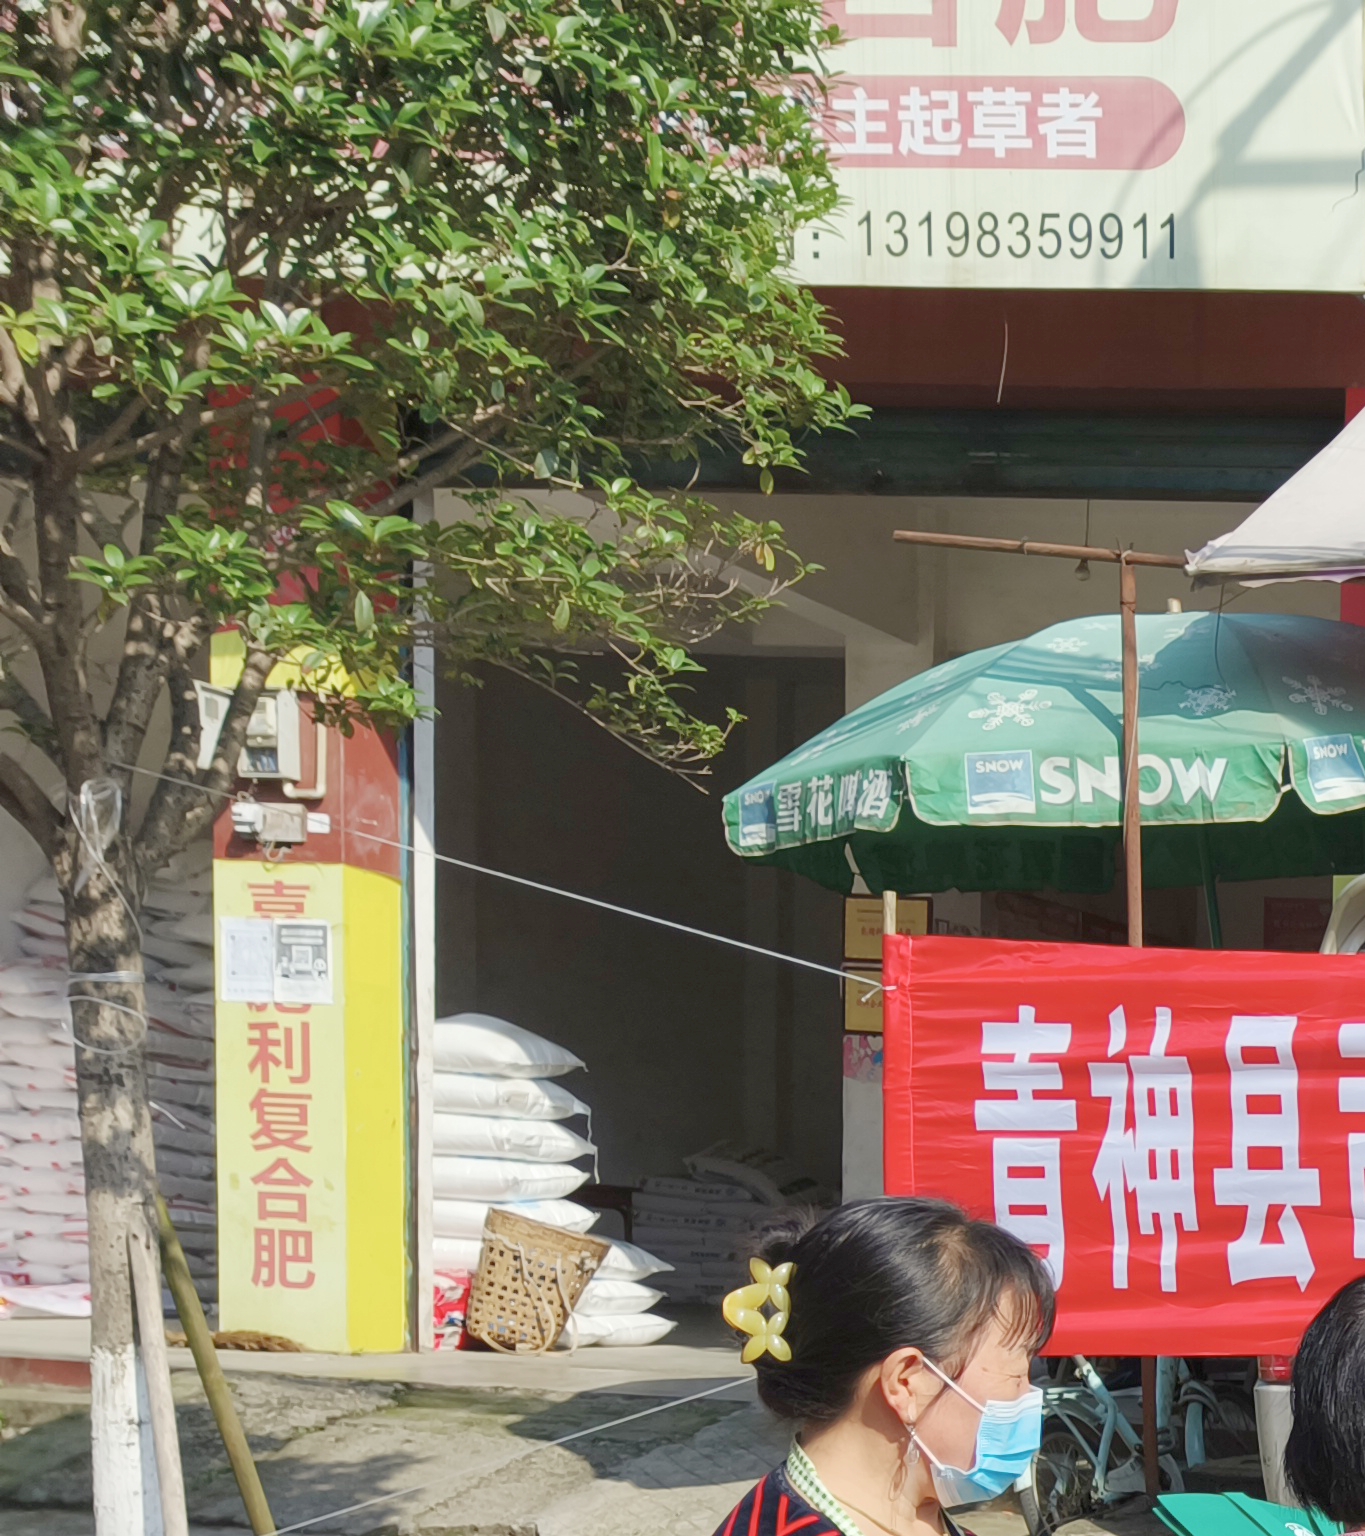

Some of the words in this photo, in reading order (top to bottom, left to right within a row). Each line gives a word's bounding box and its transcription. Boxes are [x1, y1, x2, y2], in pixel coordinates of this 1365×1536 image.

[764, 86, 1104, 158] 主起草者
[856, 210, 1177, 259] 13198359911
[975, 758, 1025, 774] SNOW
[1313, 743, 1348, 760] SNOW
[776, 769, 892, 832] 雪花啤酒
[1039, 754, 1229, 806] SNOW
[246, 880, 317, 1290] 利复合肥
